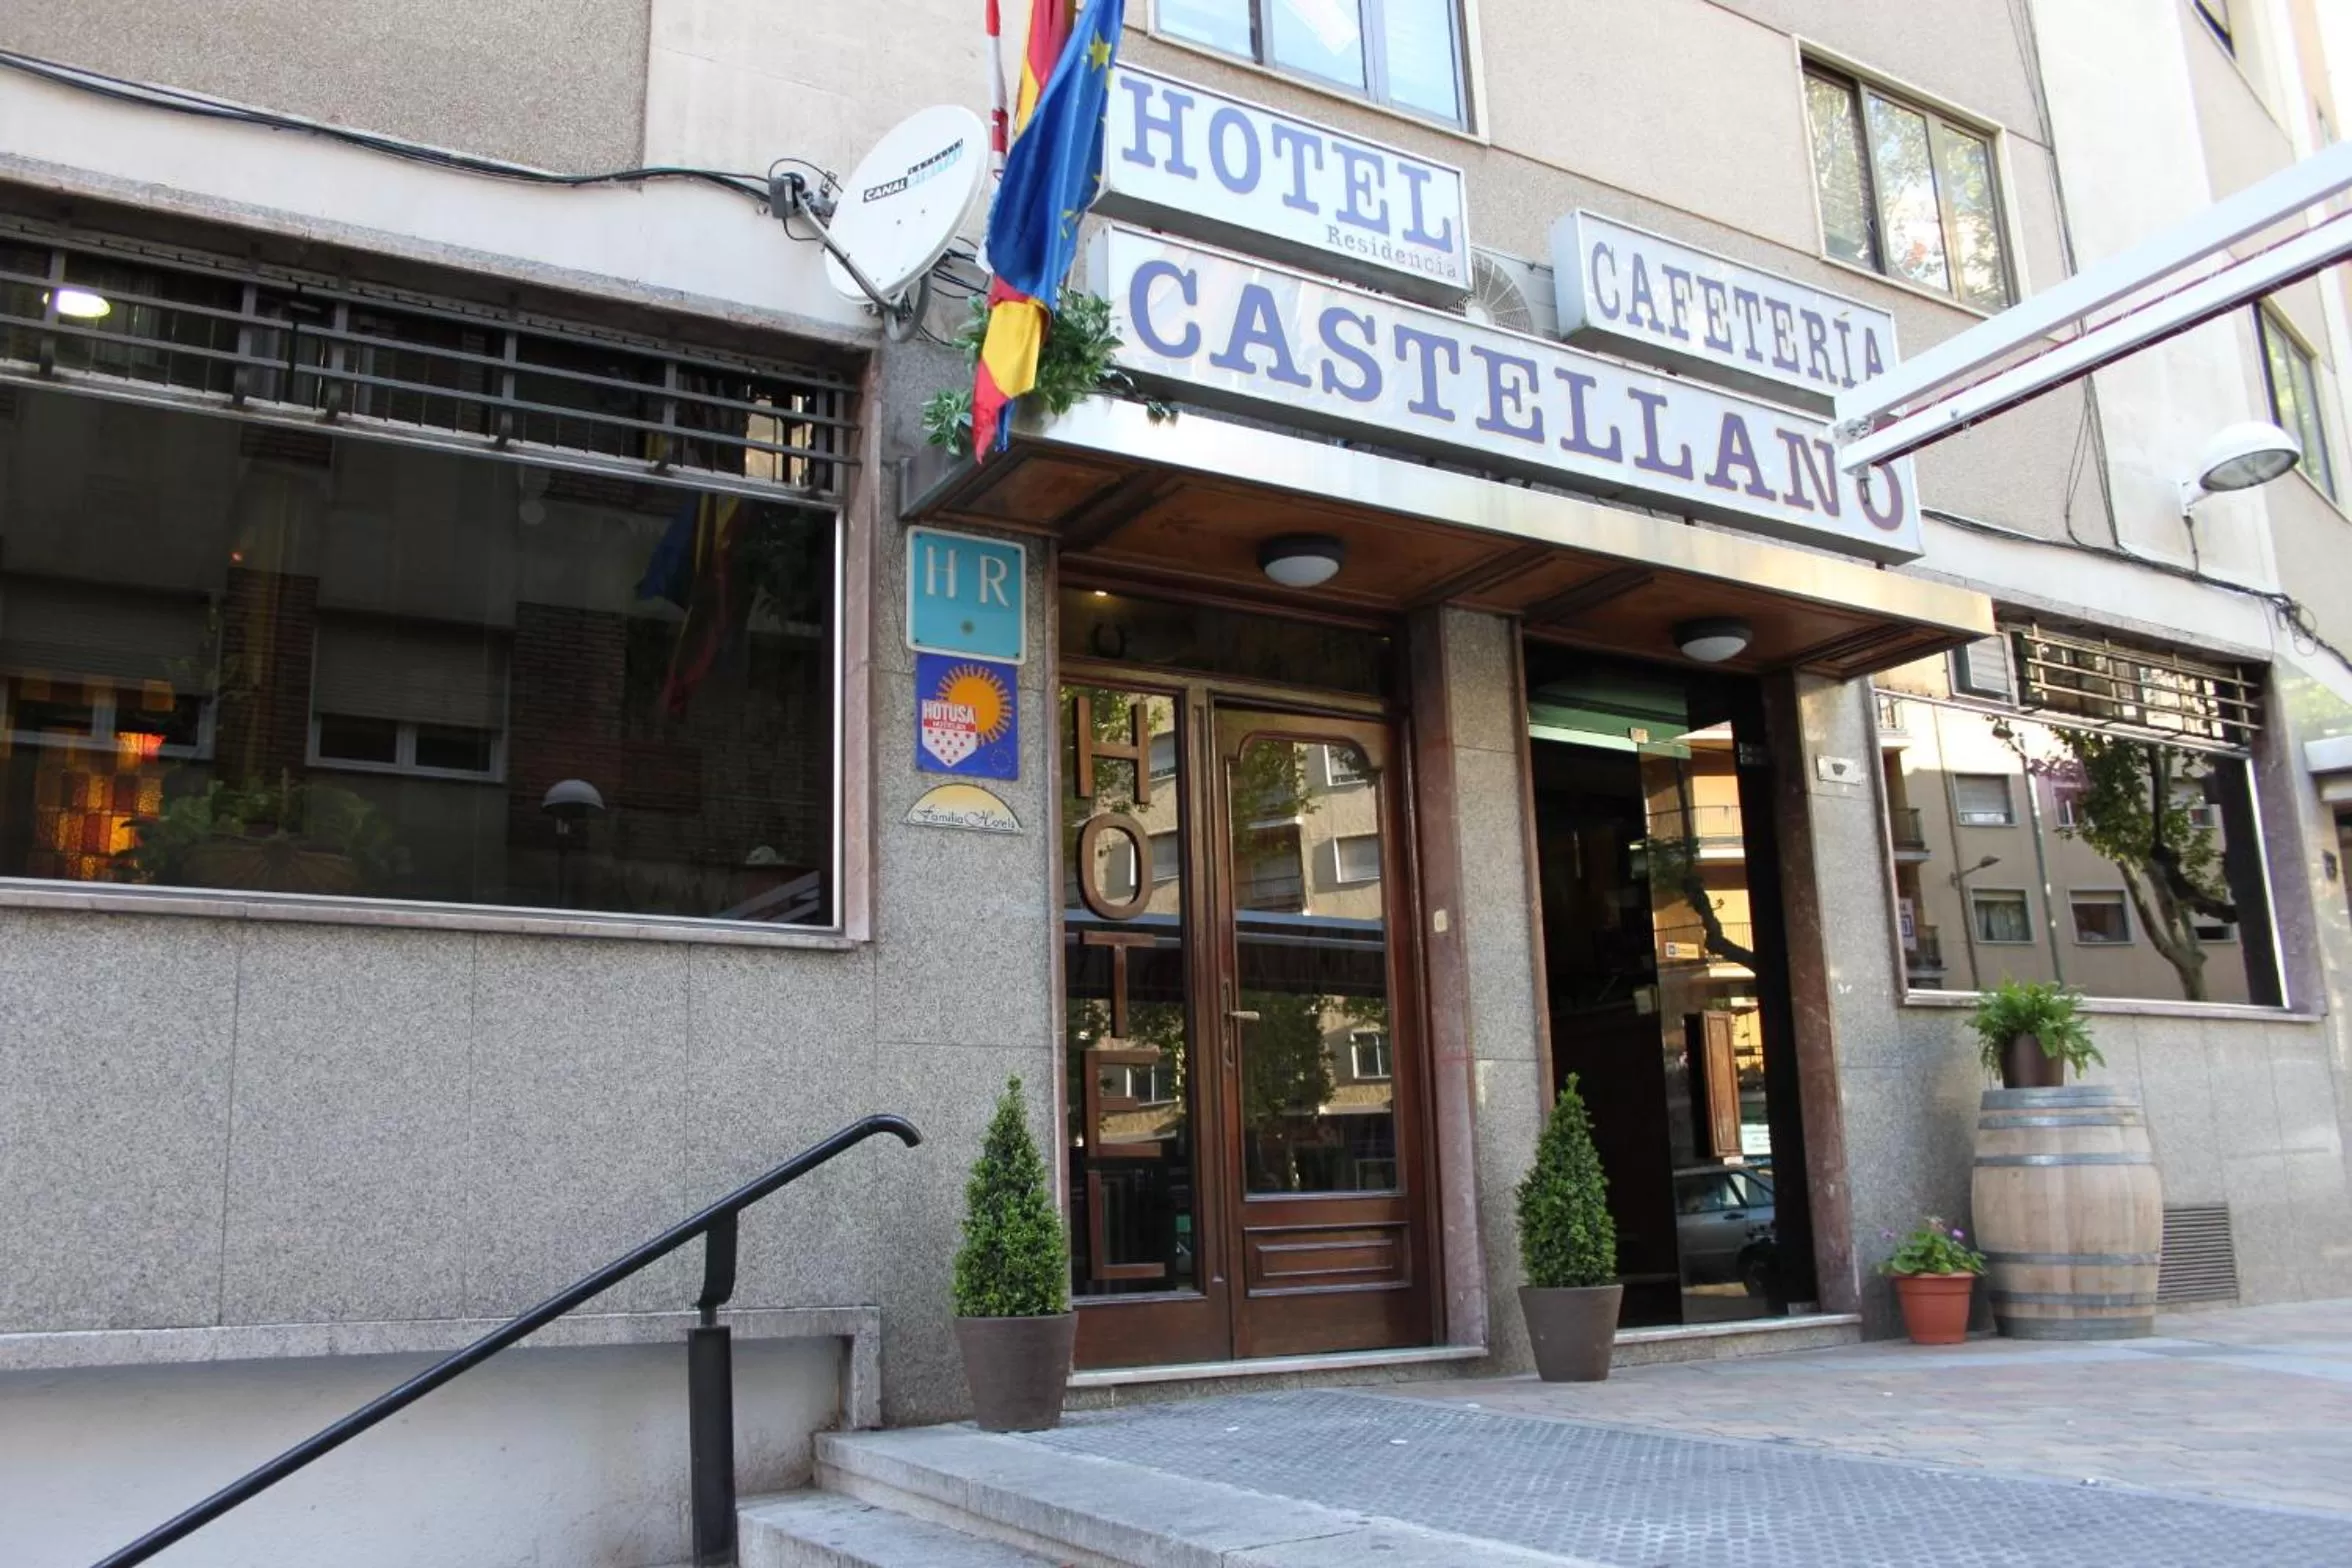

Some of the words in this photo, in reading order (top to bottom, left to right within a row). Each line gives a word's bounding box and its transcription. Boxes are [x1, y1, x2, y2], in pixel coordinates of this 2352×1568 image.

[864, 178, 906, 201] CANAL
[1122, 78, 1453, 253] HOTEL
[1326, 224, 1456, 278] Residencia
[925, 703, 976, 724] HOTUSA
[1075, 695, 1165, 1280] HOTEL
